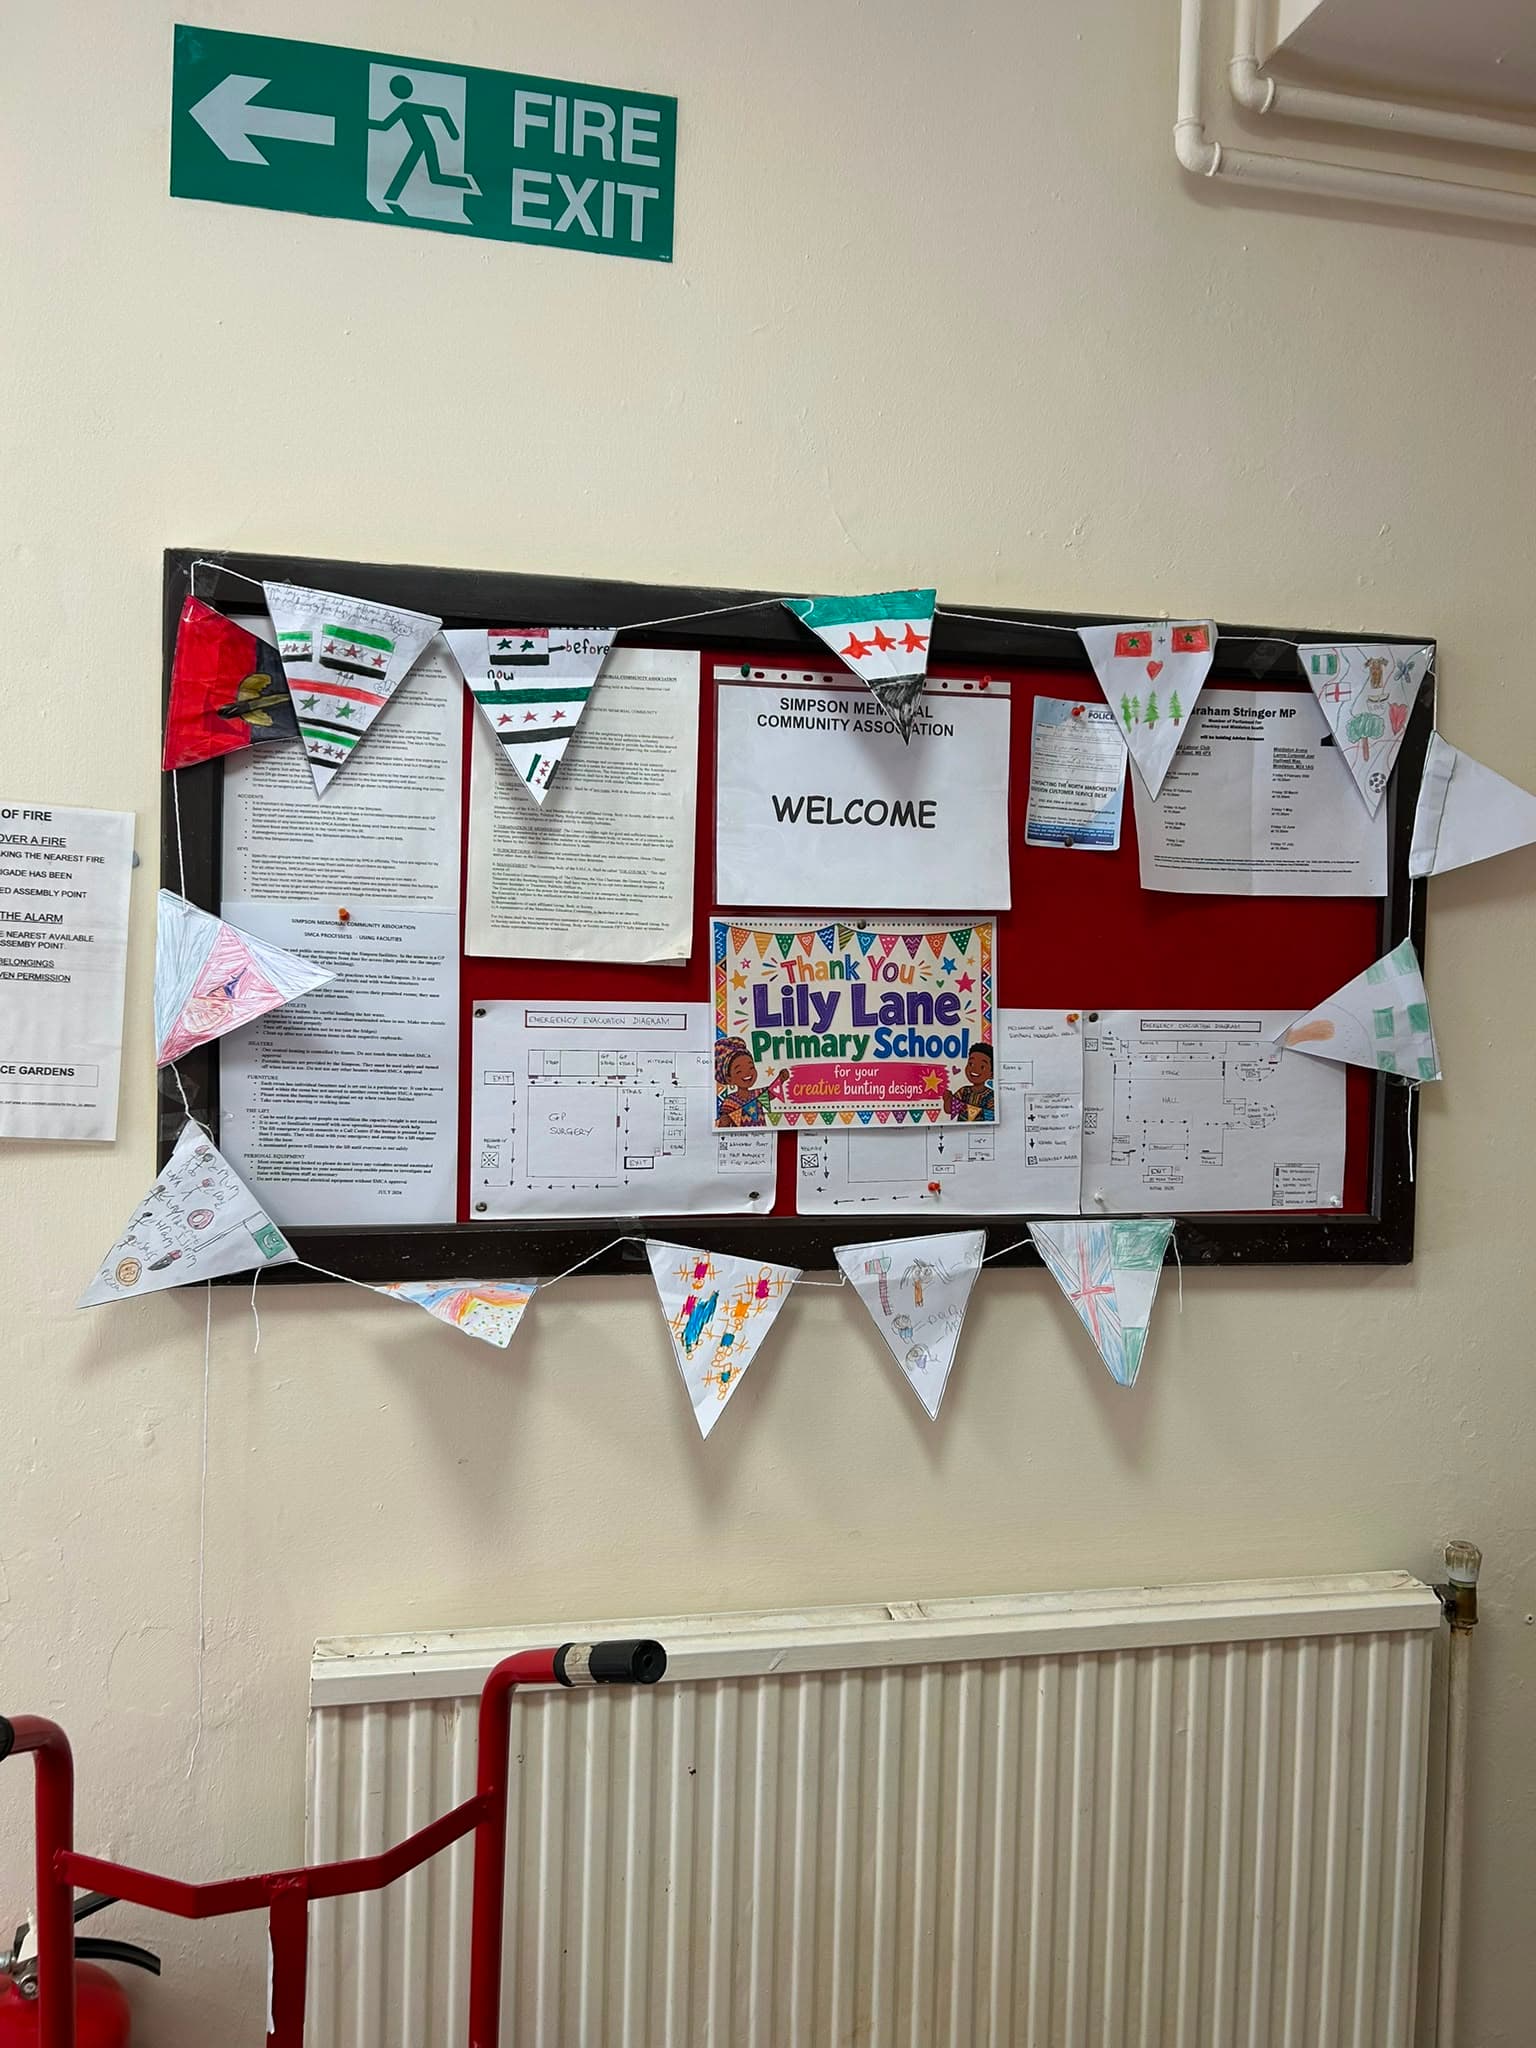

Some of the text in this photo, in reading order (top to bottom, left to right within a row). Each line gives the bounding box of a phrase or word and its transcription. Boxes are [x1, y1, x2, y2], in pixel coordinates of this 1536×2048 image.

[513, 89, 661, 168] FIRE
[511, 168, 660, 243] EXIT
[565, 638, 610, 656] before
[487, 670, 514, 681] now
[780, 697, 933, 718] SIMPSON MEMAL
[1233, 707, 1277, 719] Stringer
[1279, 708, 1297, 718] MP
[757, 714, 954, 736] COMMUNITY ASSOATION
[1, 808, 52, 821] OF FIRE
[772, 795, 937, 829] WELCOME
[31, 836, 38, 844] A
[41, 837, 66, 846] FIRE
[25, 852, 41, 860] THE
[44, 853, 83, 862] NEAREST
[86, 855, 105, 864] FIRE
[29, 870, 47, 879] HAS
[49, 871, 73, 880] BEEN
[13, 888, 60, 897] ASSEMBLY
[61, 890, 87, 899] POINT
[0, 911, 63, 923] THE ALARM
[347, 921, 380, 929] COMMUNITY
[6, 931, 47, 940] NEAREST
[49, 933, 94, 943] AVAILABLE
[780, 954, 916, 985] Thank You
[17, 972, 71, 983] PERMISSION
[752, 983, 962, 1034] Lily Lane
[529, 1016, 578, 1025] EMERGENCY
[633, 1017, 670, 1025] DIAGRAM
[751, 1027, 970, 1062] Primary School
[0, 1065, 74, 1076] CE GARDENS
[834, 1064, 879, 1082] for your
[793, 1081, 923, 1098] creative bunting designs
[548, 1112, 567, 1122] GP
[550, 1127, 594, 1137] SURGERY
